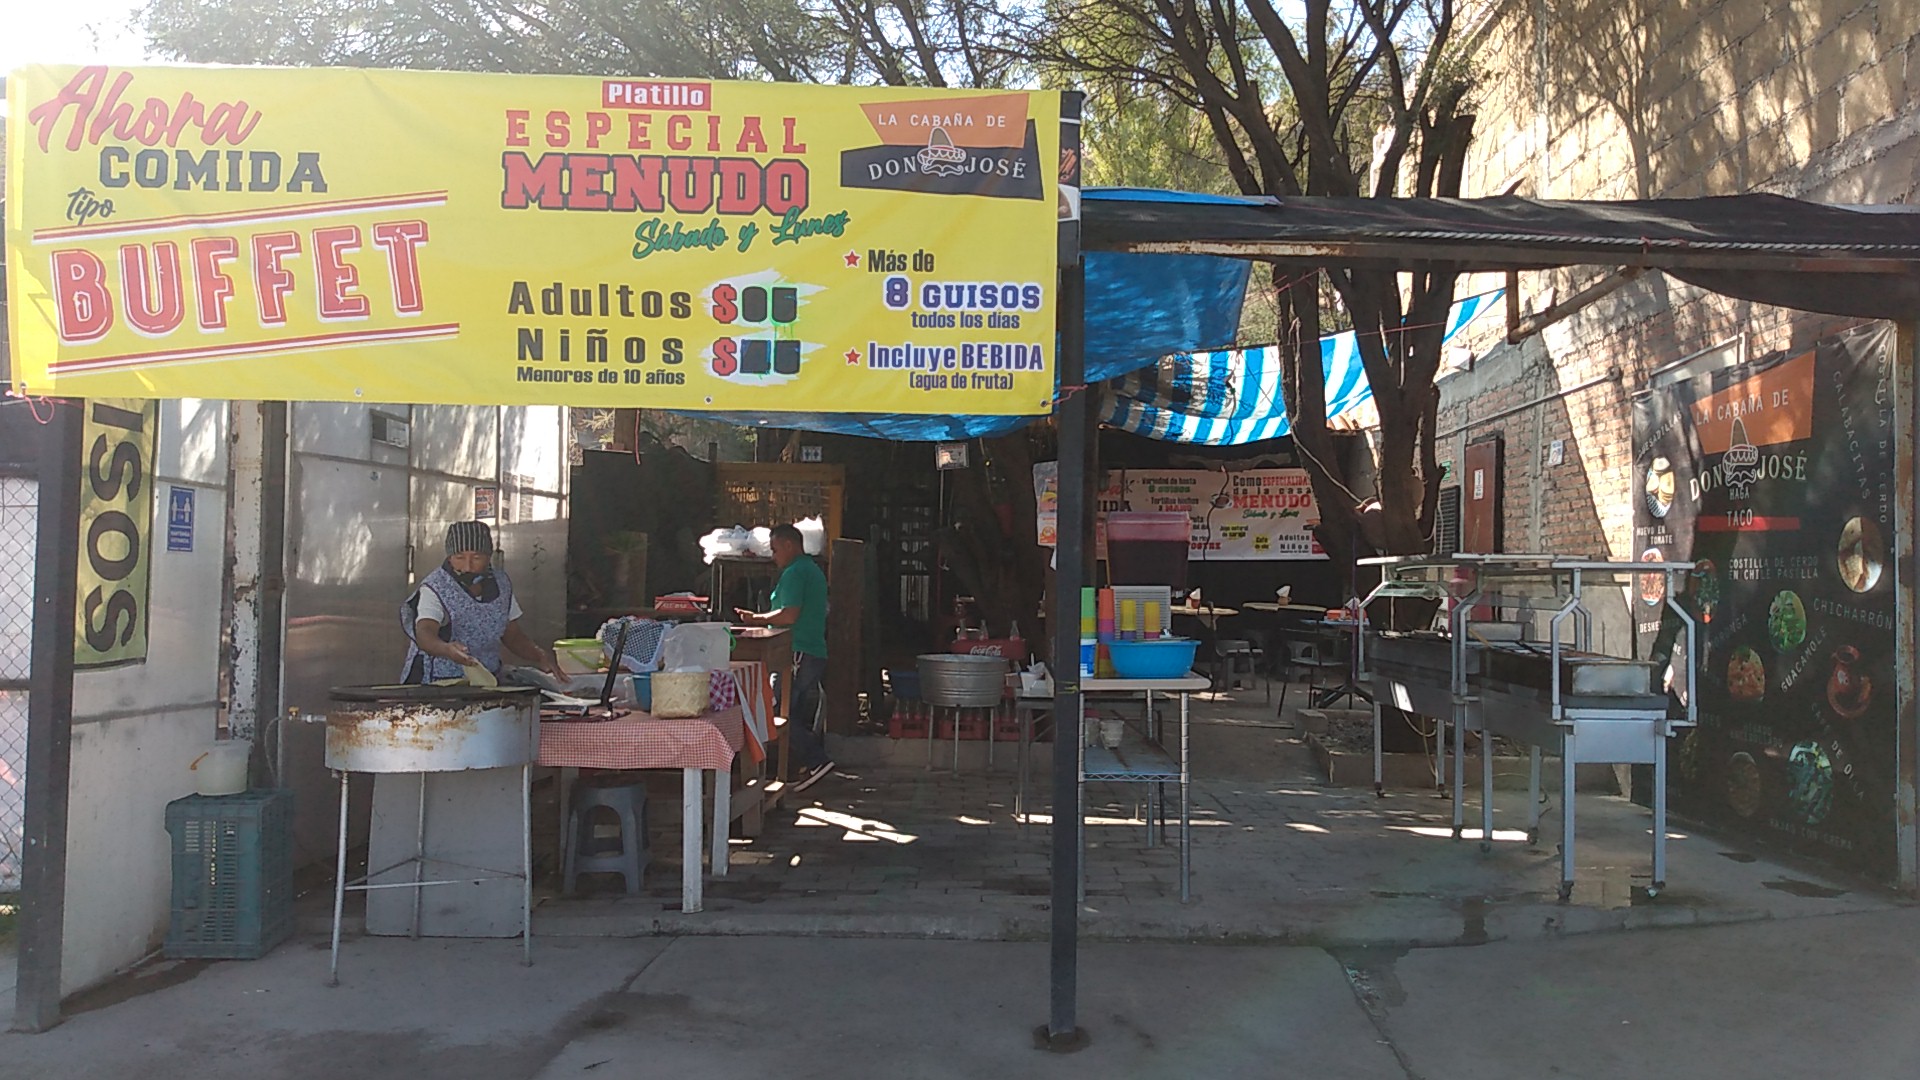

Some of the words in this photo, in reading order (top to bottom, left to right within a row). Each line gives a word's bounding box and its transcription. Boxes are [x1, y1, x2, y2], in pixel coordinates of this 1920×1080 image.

[28, 65, 262, 153] Ahora
[608, 83, 704, 107] Platillo
[507, 111, 806, 153] ESPECIAL
[878, 112, 898, 127] LA
[909, 112, 974, 128] CABAÑA
[986, 115, 1006, 128] DE
[100, 145, 328, 193] COMIDA
[502, 152, 810, 215] MENUDO
[868, 157, 916, 181] DON
[964, 156, 1027, 179] JOSÉ
[66, 187, 116, 225] tipo
[632, 219, 729, 260] Sábado
[738, 223, 759, 250] y
[770, 207, 851, 244] Lunes
[868, 249, 907, 273] Más
[912, 251, 934, 272] de
[50, 220, 429, 345] BUFFET
[884, 276, 909, 309] 8
[923, 282, 1041, 310] GUISOS
[508, 281, 692, 319] Adultos
[911, 311, 955, 328] todos
[959, 311, 980, 328] los
[984, 311, 1020, 329] días
[518, 328, 684, 364] Niños
[868, 342, 957, 372] Incluye
[961, 343, 1043, 371] BEBIDA
[517, 369, 595, 383] Menores
[598, 371, 618, 384] de
[623, 370, 641, 384] 10
[646, 370, 685, 385] años
[909, 372, 943, 391] (agua
[946, 372, 966, 389] de
[970, 372, 1013, 390] fruta)
[1696, 410, 1710, 425] LA
[1717, 394, 1763, 420] CABAÑA
[1773, 389, 1789, 407] DE
[1832, 370, 1871, 500] CALABACITAS
[1233, 475, 1261, 486] Como
[1233, 487, 1249, 495] de
[1257, 487, 1270, 495] la
[1690, 465, 1722, 502] DON
[1757, 450, 1809, 482] JOSÉ
[1232, 494, 1311, 508] MENUDO
[1729, 487, 1750, 500] HAGA
[1879, 473, 1888, 524] CERDO
[1727, 508, 1753, 527] TACO
[1650, 535, 1673, 545] TOMATE
[1729, 557, 1769, 570] COSTILLA
[1743, 568, 1771, 580] CHILE
[1813, 598, 1893, 630] CHICHARRÓN
[1781, 626, 1827, 692] GUACAMOLE
